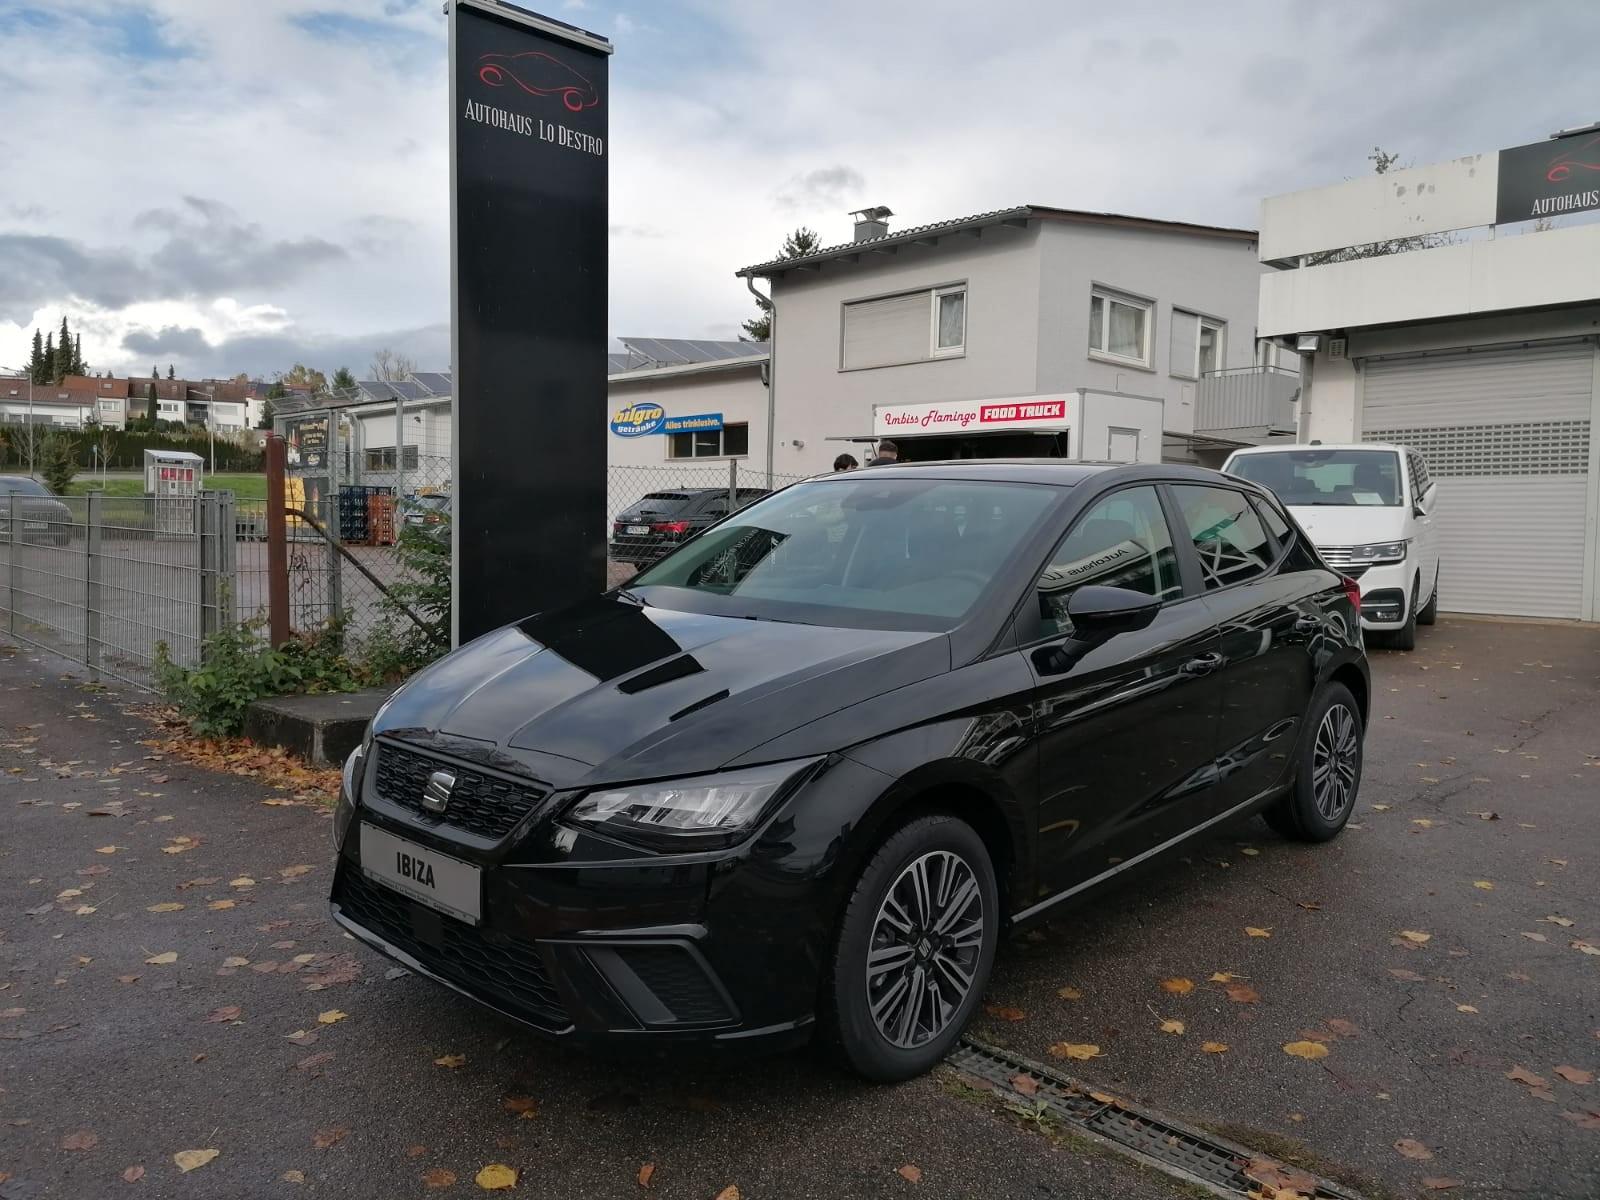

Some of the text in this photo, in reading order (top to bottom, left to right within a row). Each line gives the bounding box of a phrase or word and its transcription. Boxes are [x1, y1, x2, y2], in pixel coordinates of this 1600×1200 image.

[465, 99, 532, 136] AUTOHAUS
[558, 125, 603, 156] DESTRO
[1531, 190, 1599, 216] AUTOHAUS
[613, 402, 663, 425] bilgro
[665, 421, 682, 430] Alles
[885, 403, 1062, 427] Imbiss Flamingo FOOD TRUCK
[396, 851, 436, 889] IBIZA
